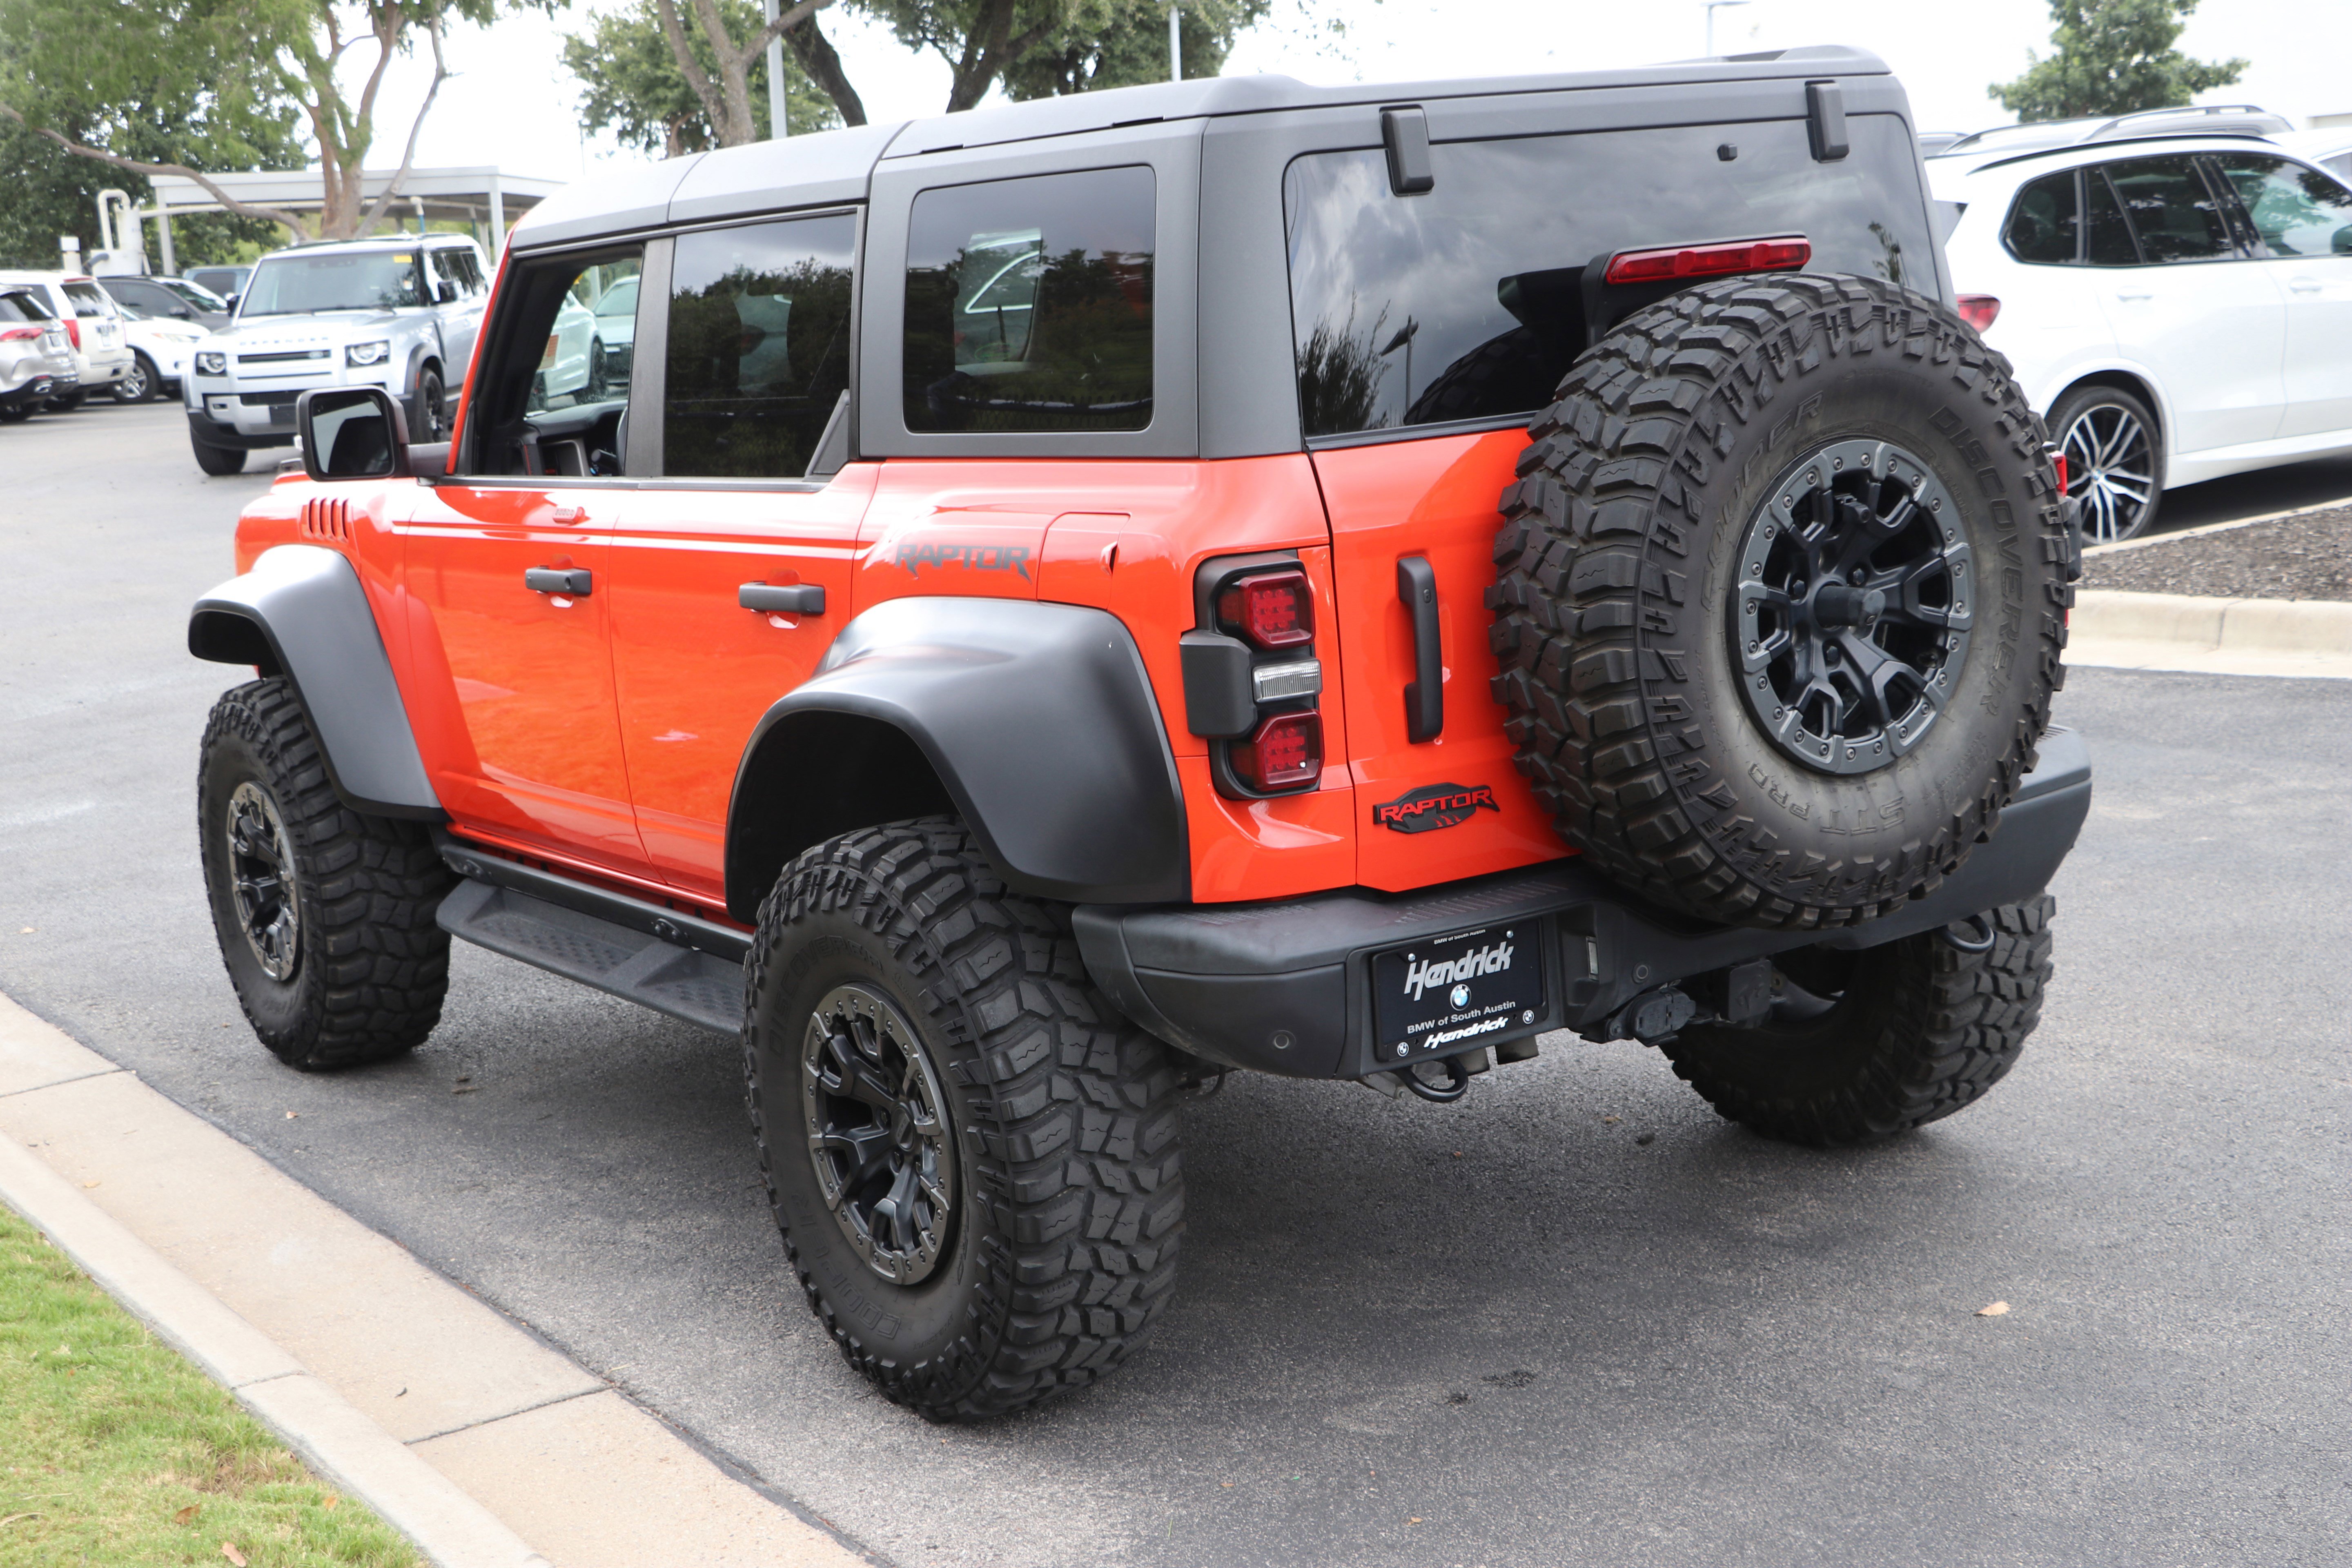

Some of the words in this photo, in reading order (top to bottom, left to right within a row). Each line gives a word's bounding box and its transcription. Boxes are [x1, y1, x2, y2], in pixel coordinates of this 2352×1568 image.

[239, 337, 328, 346] DEFENDER
[1701, 390, 1824, 611] COOPER
[894, 543, 1033, 585] RAPTOR
[1927, 404, 2023, 716] DISCOVERER
[1379, 788, 1494, 822] RAPTOR
[1748, 763, 1811, 820] PRO
[1820, 796, 1905, 835] STT
[1404, 941, 1514, 1001] Hendrick
[769, 935, 885, 1058] DISCOVERER
[1408, 1020, 1435, 1034] BMW
[1438, 1016, 1448, 1026] of
[1451, 1009, 1481, 1022] South
[1483, 1001, 1515, 1015] Austin
[1423, 1016, 1508, 1049] Hendrick
[791, 1193, 901, 1339] COOPER
